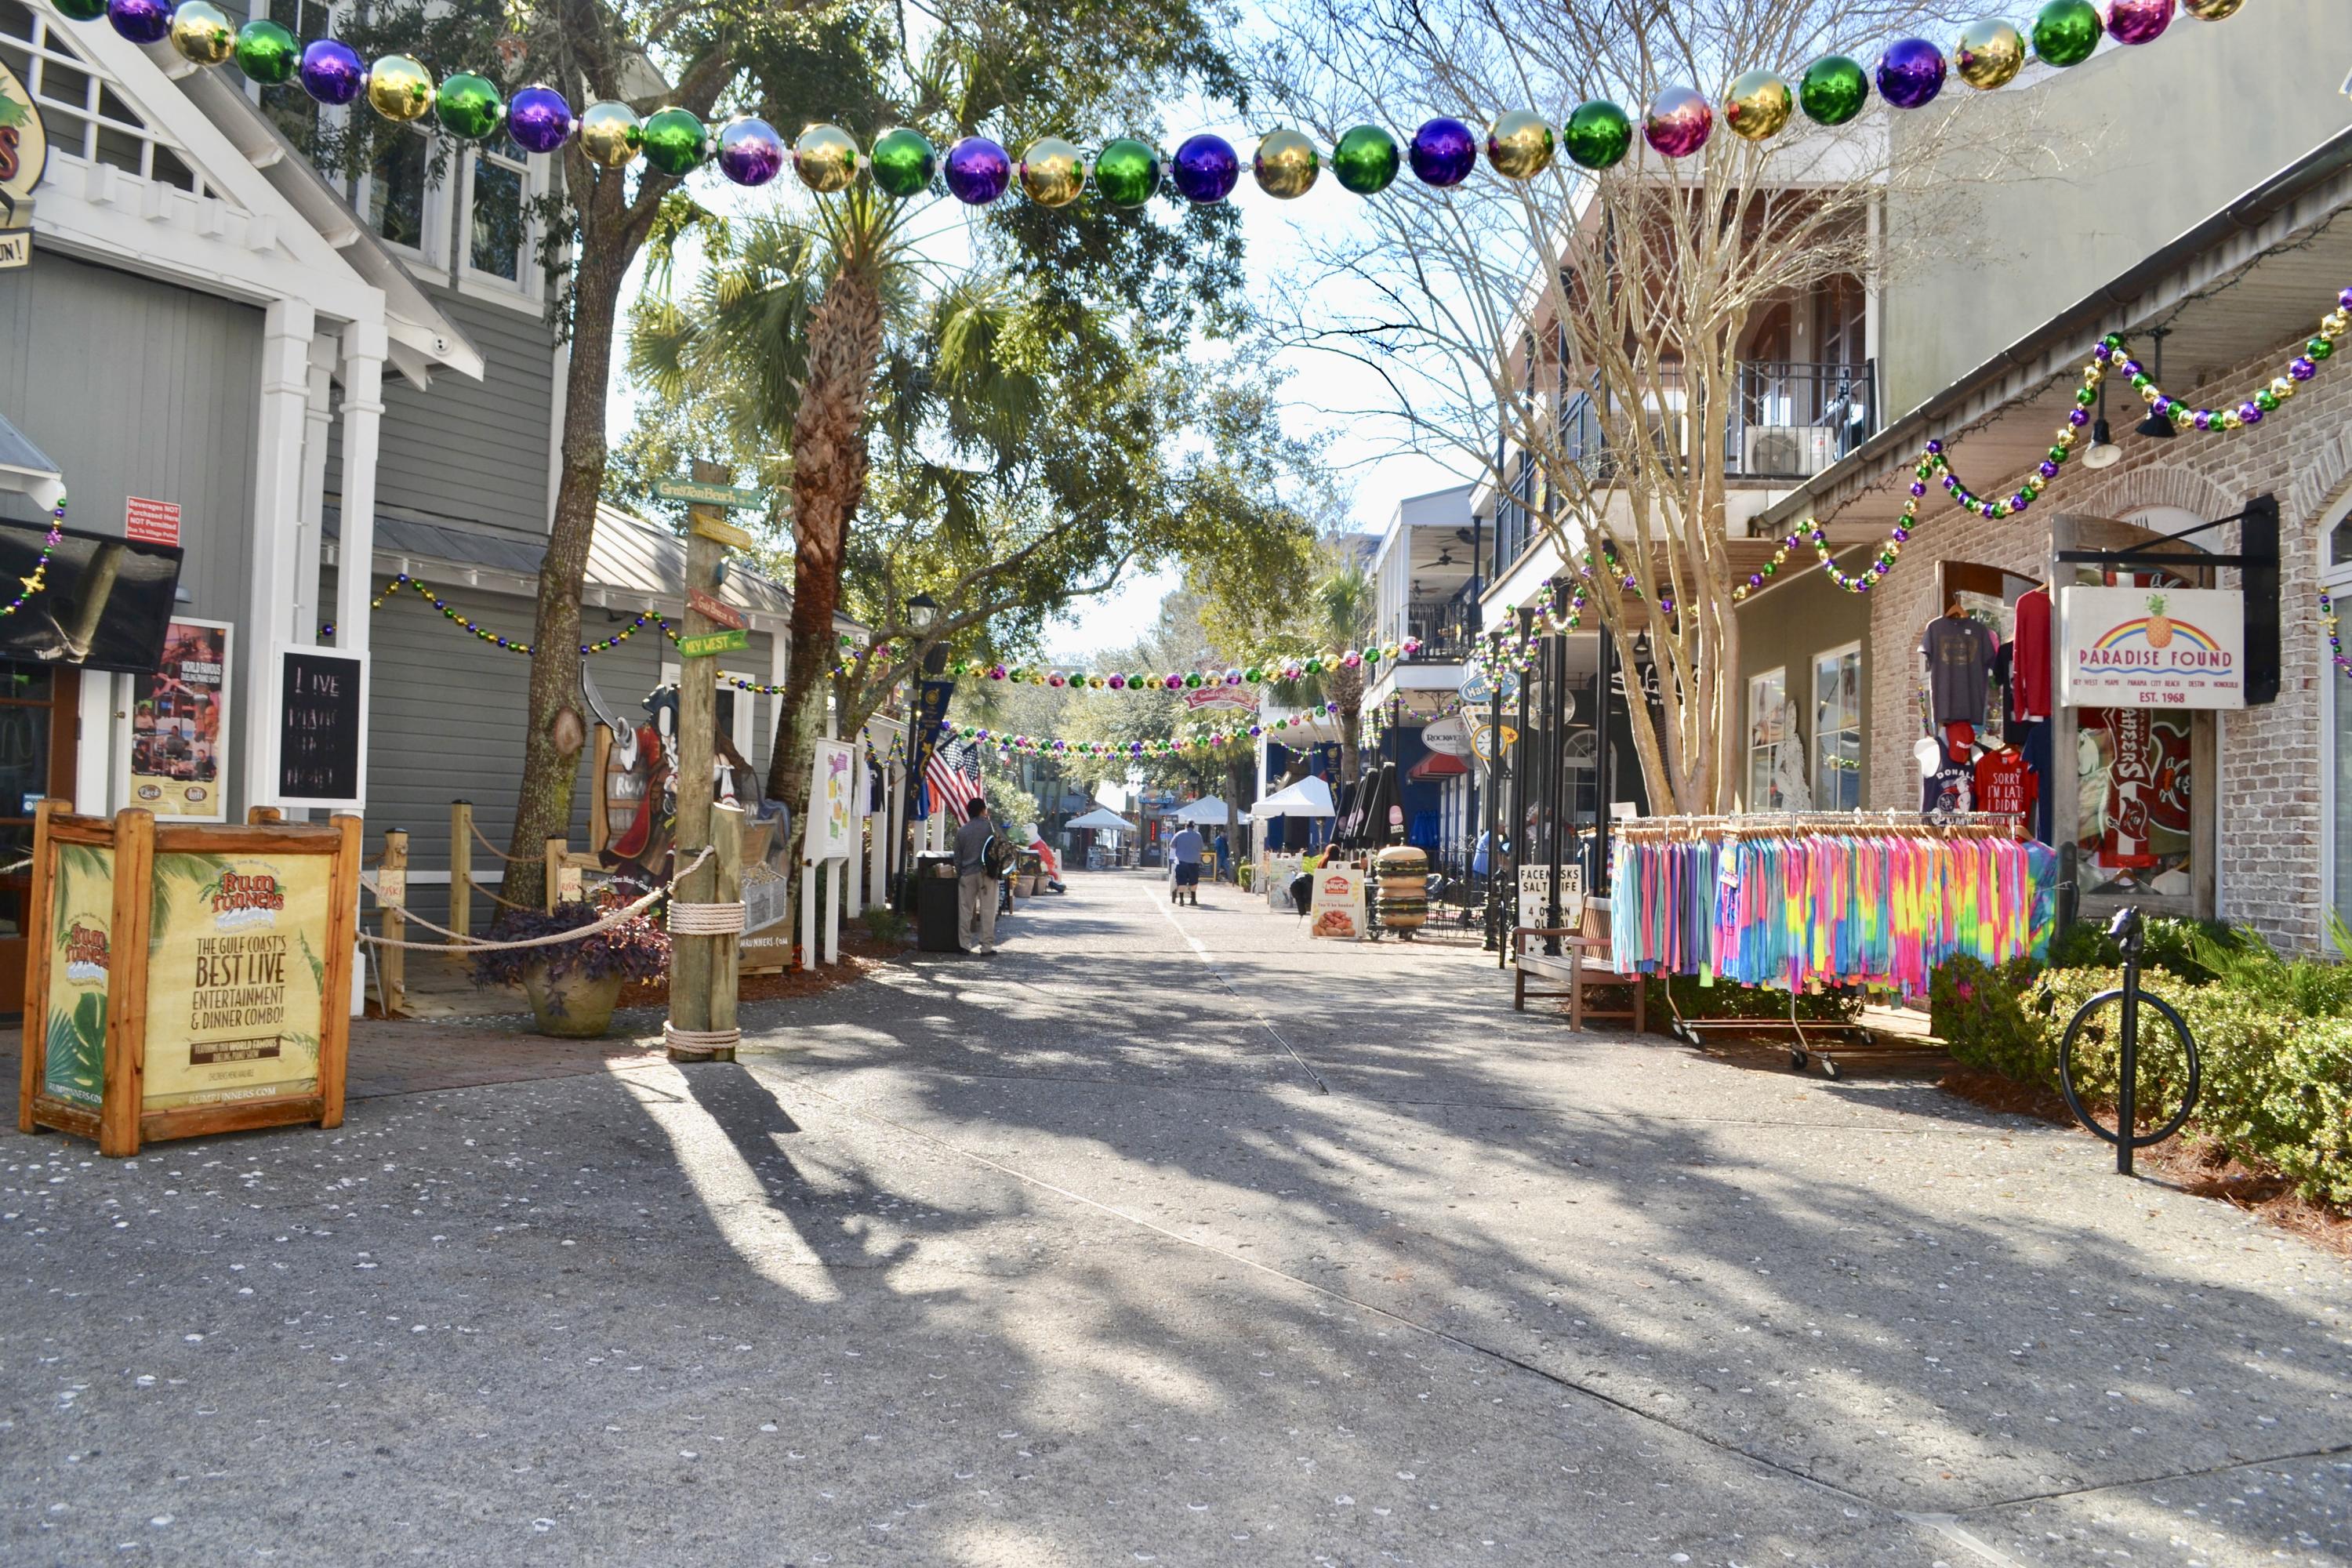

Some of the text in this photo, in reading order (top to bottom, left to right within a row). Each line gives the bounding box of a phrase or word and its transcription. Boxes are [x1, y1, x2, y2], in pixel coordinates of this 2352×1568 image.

[129, 499, 178, 514] Beverages NOT
[129, 508, 163, 519] Purchased
[130, 517, 176, 530] NOT Permitted
[685, 636, 728, 653] KEY WEST
[2080, 650, 2232, 666] PARADISE FOUND
[182, 661, 221, 675] WORLD FAMOUS
[295, 666, 339, 697] LIVE
[2140, 691, 2185, 703] EST. 1968
[1993, 772, 2020, 785] SORRY
[1988, 785, 2000, 798] I'M
[1988, 799, 1991, 811] I
[223, 873, 275, 893] Rum
[1523, 882, 1548, 891] SALT
[1529, 906, 1534, 916] 4
[72, 924, 105, 948] Rum
[197, 935, 286, 955] THE GULF COAST'S
[196, 953, 285, 988] BEST LIVE
[193, 985, 285, 1010] ENTERTAINMENT
[191, 1006, 284, 1030] & DINNER COMBO!
[229, 1040, 252, 1051] WORLD
[252, 1038, 277, 1049] FAMOUS
